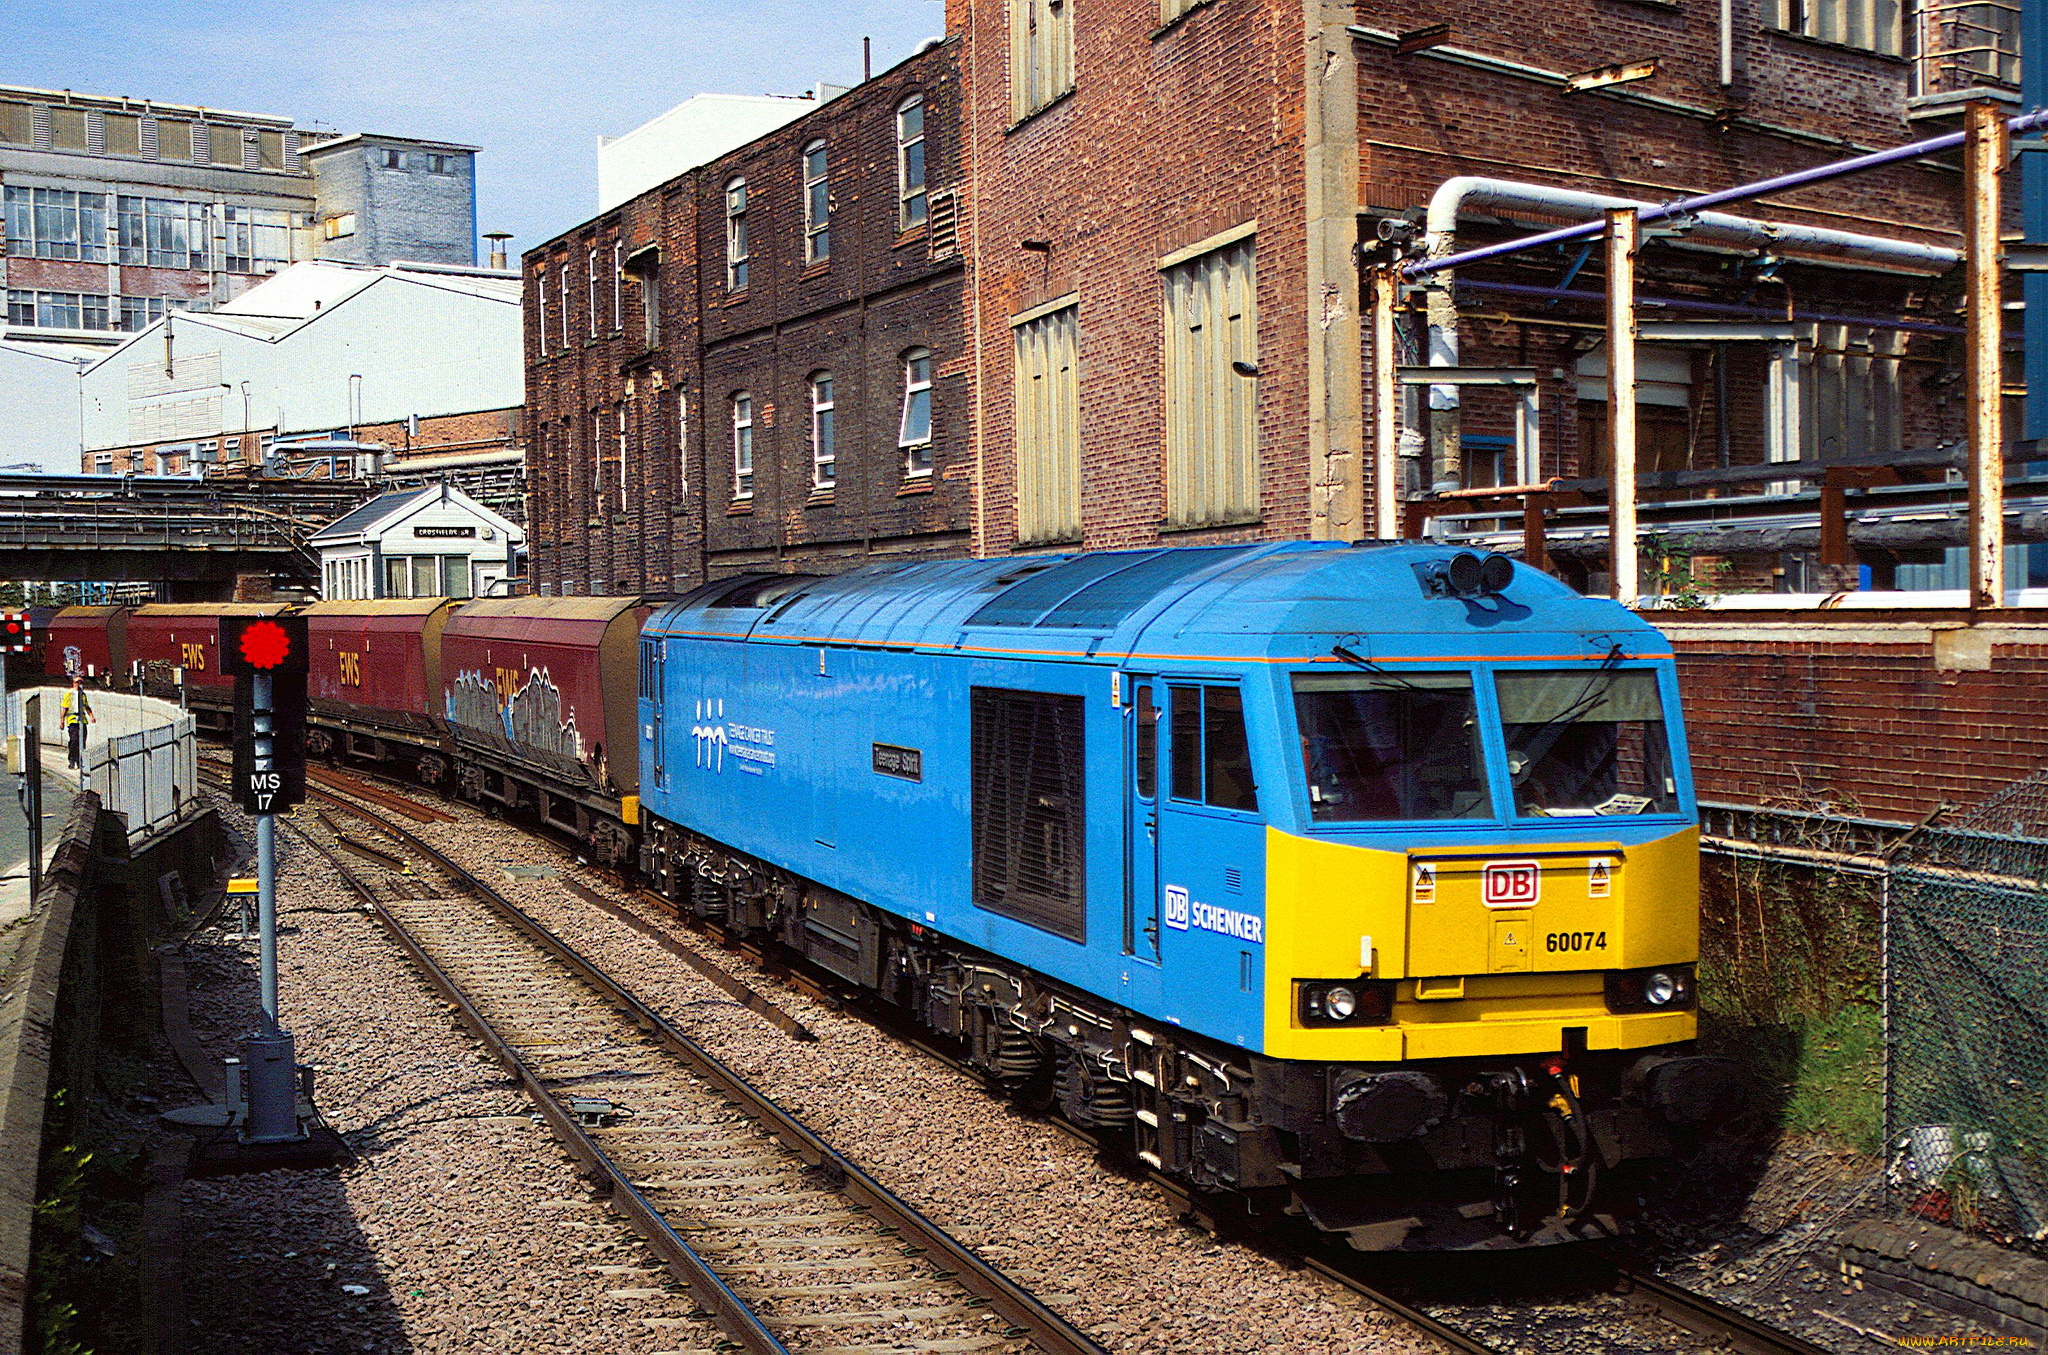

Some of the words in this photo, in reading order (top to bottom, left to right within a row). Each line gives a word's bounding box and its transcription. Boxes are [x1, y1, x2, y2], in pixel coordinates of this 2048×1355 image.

[181, 643, 205, 670] EWS
[339, 651, 360, 687] EWS
[250, 773, 281, 790] MS
[258, 794, 273, 811] 17
[1492, 870, 1531, 897] DB
[1168, 891, 1187, 922] DB
[1192, 901, 1263, 944] SCHENKER
[1546, 931, 1607, 952] 60074
